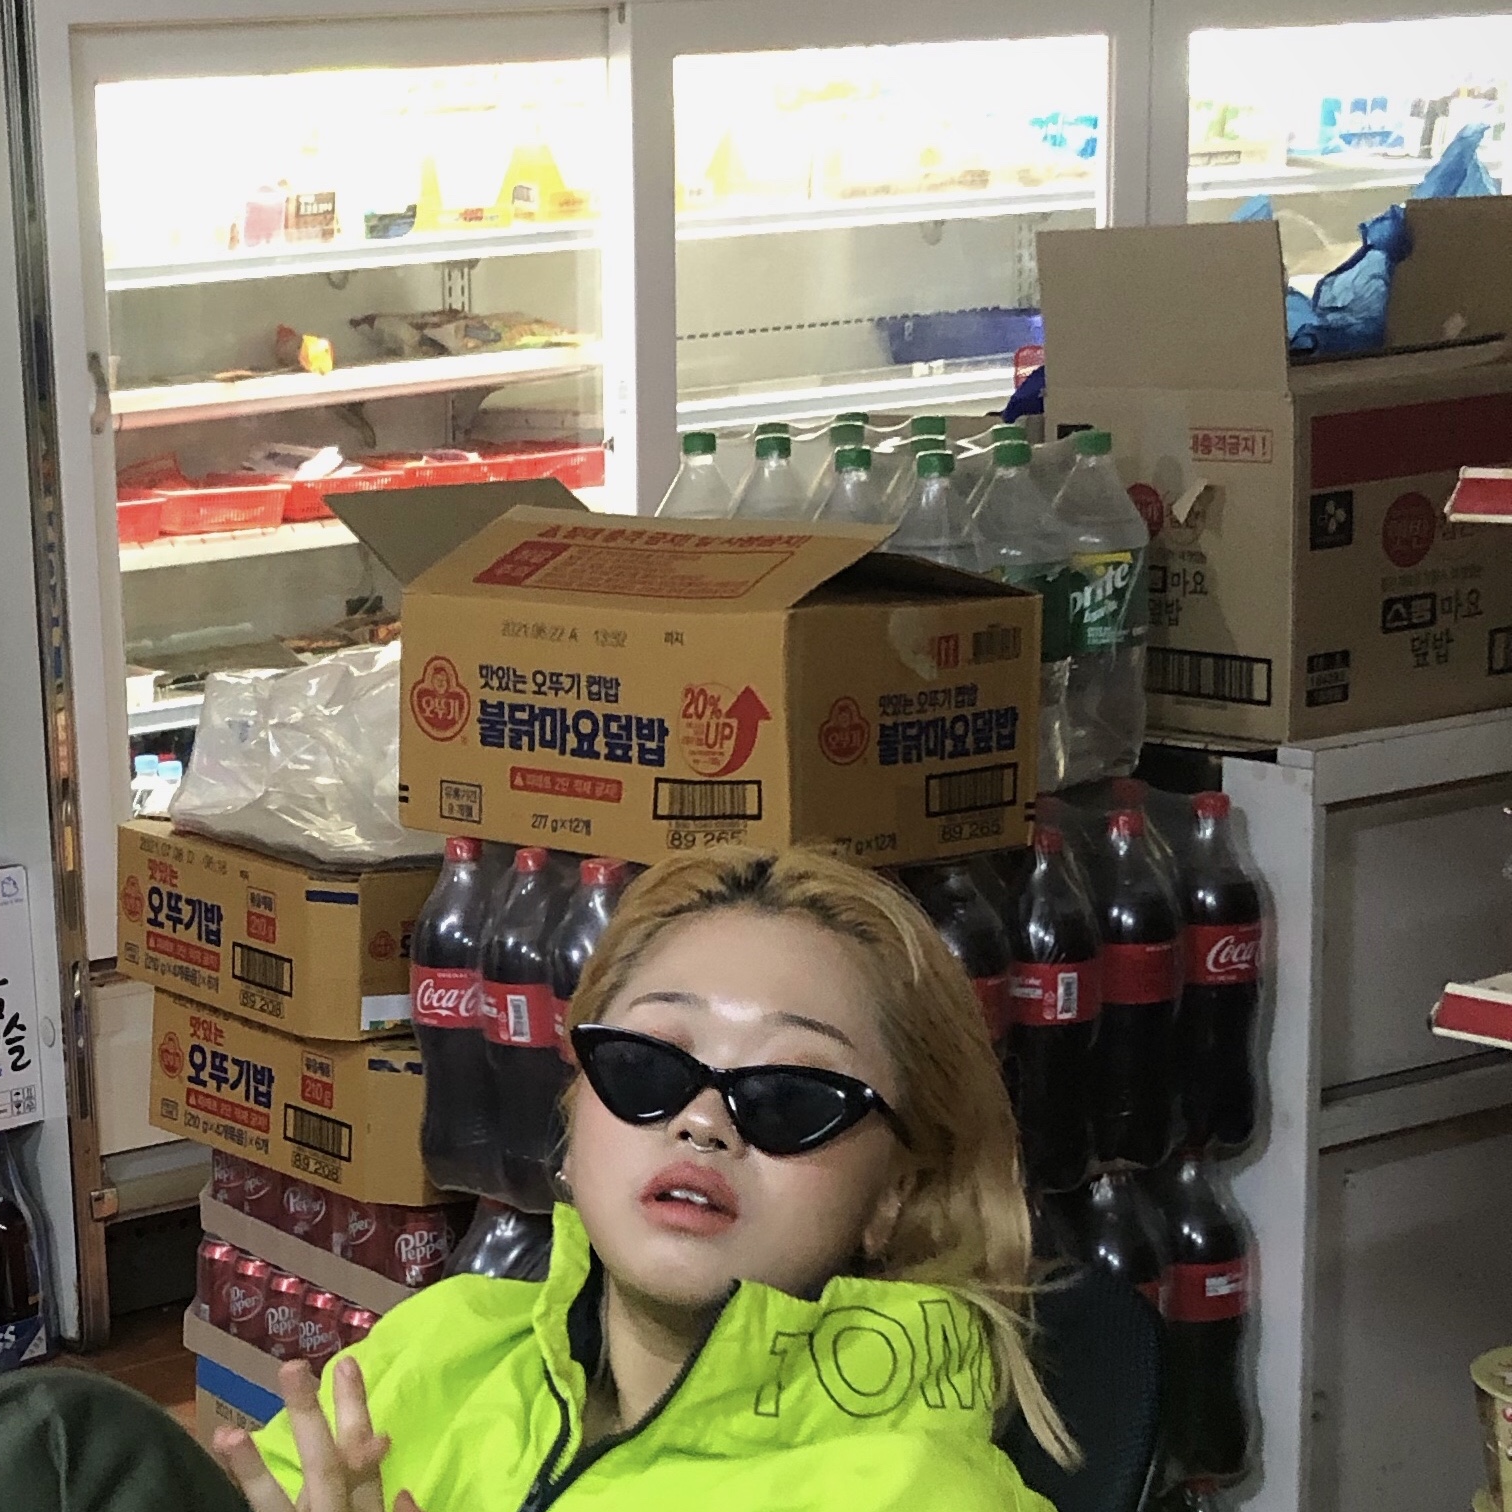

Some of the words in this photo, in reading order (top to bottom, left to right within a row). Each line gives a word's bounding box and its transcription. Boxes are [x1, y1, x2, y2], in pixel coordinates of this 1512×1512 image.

[478, 664, 528, 693] 맛있는
[531, 669, 582, 701] 오뚜기
[586, 674, 622, 704] 컵밥
[917, 688, 952, 714] 오뚜기
[681, 686, 723, 721] 20%
[477, 698, 670, 768] 불닭마요덮밥
[704, 720, 735, 750] UP
[877, 705, 1019, 766] 불닭마요덮밥
[670, 831, 697, 849] 89
[146, 885, 224, 948] 오뚜기밥
[189, 1015, 226, 1047] 맛있는
[187, 1043, 275, 1110] 오뚜기밥
[293, 1154, 310, 1170] 89
[314, 1160, 339, 1181] 208
